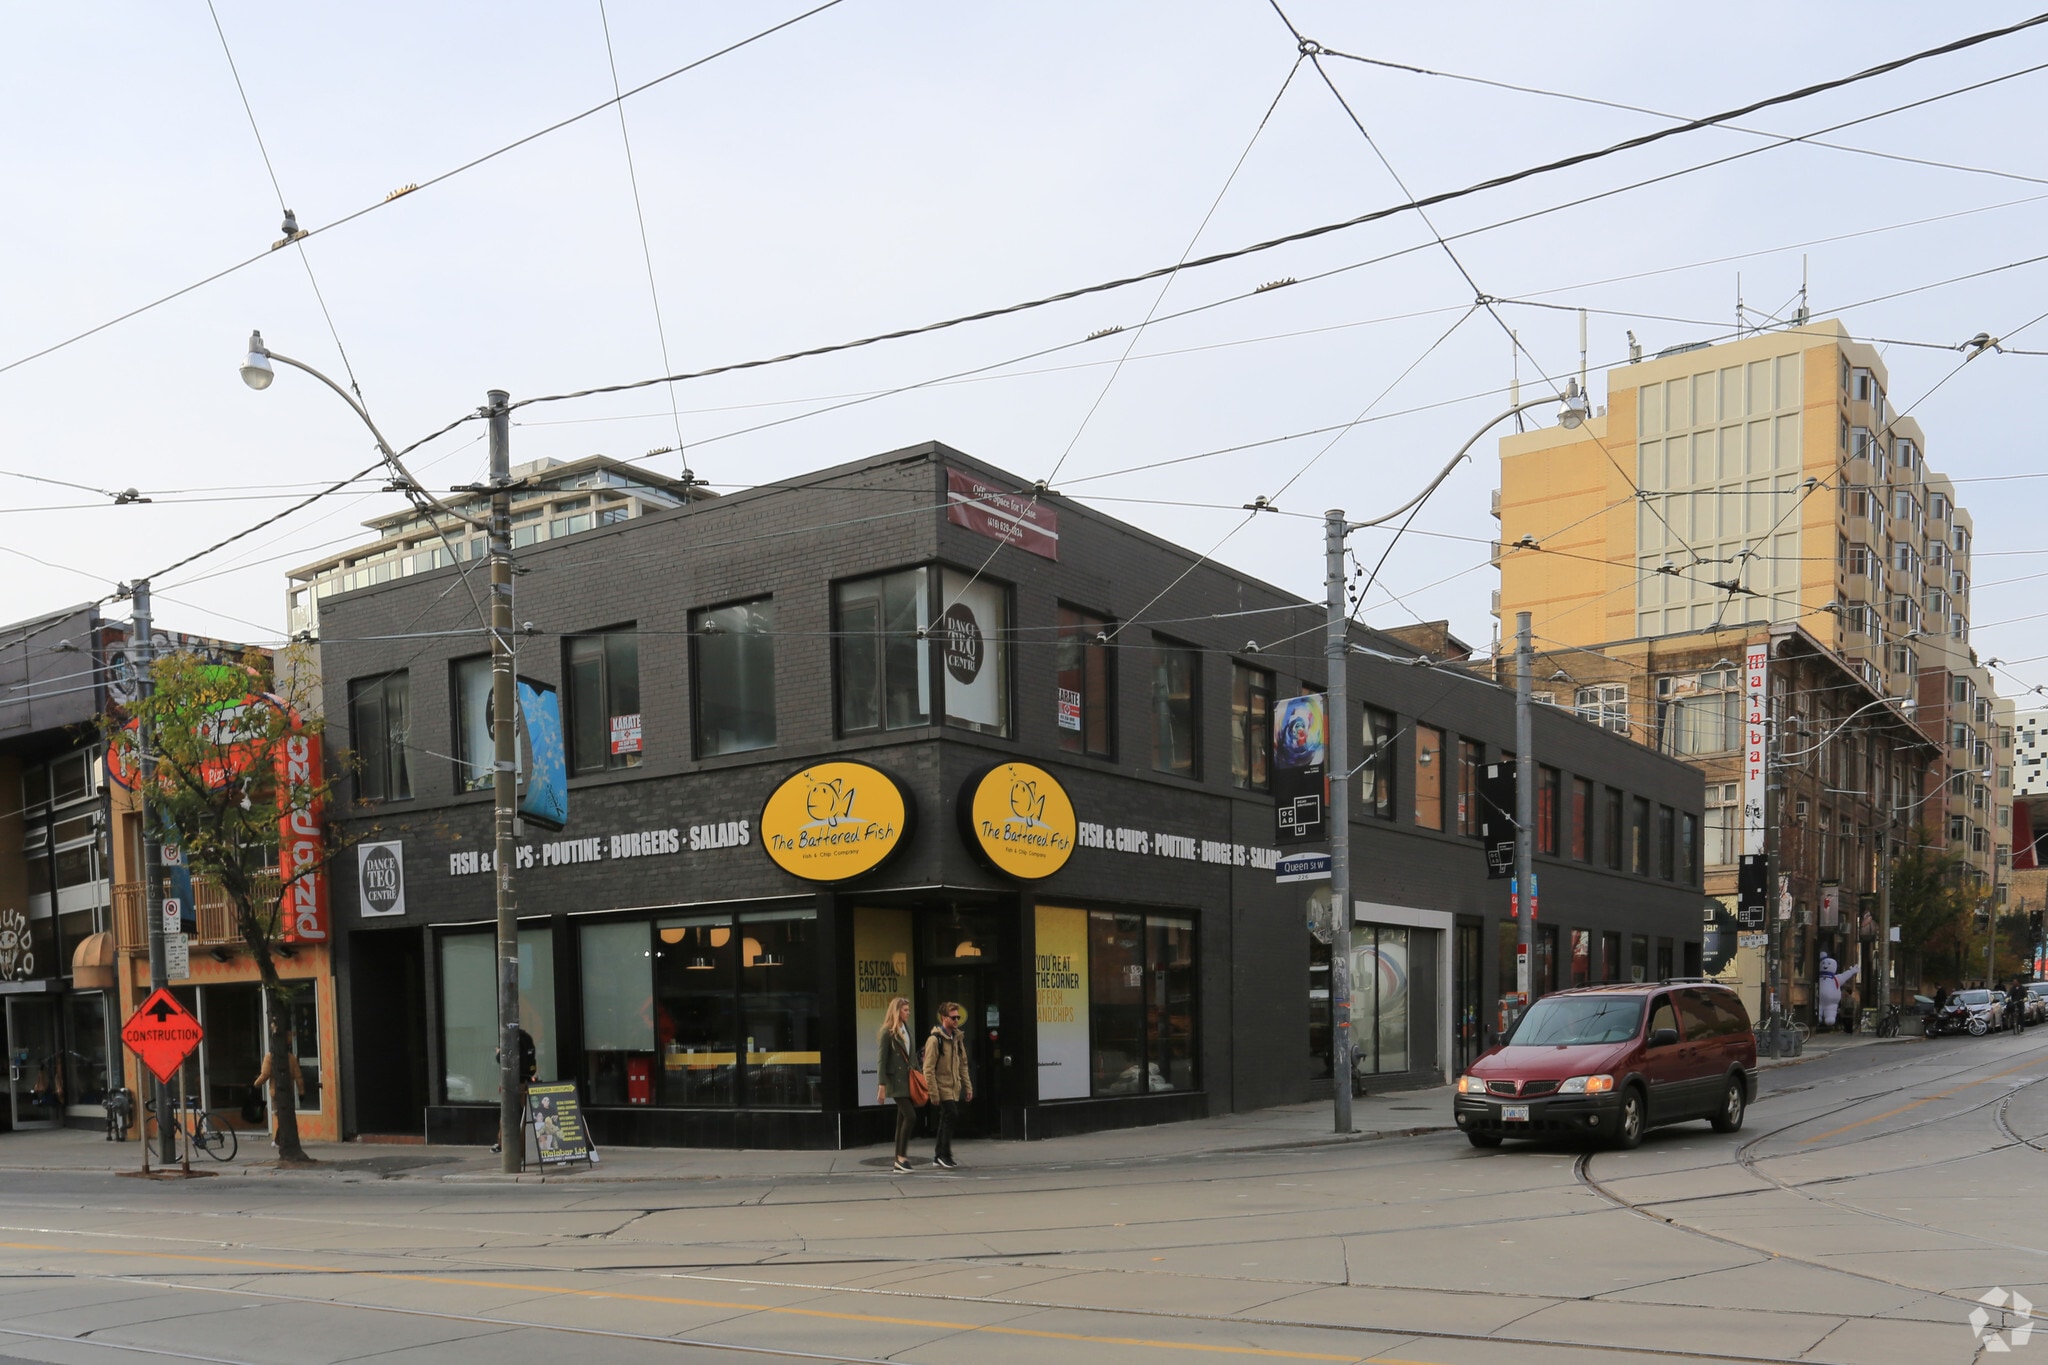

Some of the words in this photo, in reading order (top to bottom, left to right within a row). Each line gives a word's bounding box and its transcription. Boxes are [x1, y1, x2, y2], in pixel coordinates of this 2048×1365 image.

[972, 484, 993, 501] Office
[993, 494, 1011, 508] Space
[1010, 499, 1019, 512] for
[948, 630, 976, 660] TEQ
[613, 714, 641, 730] KARATE
[1747, 653, 1766, 781] Malabar
[287, 735, 321, 835] piza
[772, 834, 794, 851] The
[798, 827, 860, 849] Battered
[864, 822, 895, 840] Fish
[982, 821, 1001, 839] The
[1003, 823, 1048, 847] Battered
[1050, 832, 1071, 850] Fish
[1078, 821, 1104, 848] FISH
[1105, 829, 1115, 849] &
[1116, 827, 1149, 854] CHIPS
[1154, 833, 1196, 860] POUTINE
[449, 851, 479, 876] FISH
[480, 852, 491, 873] &
[493, 845, 534, 871] CPS
[543, 837, 601, 866] POUTINE
[611, 828, 679, 859] BURGERS
[690, 820, 750, 851] SALADS
[833, 849, 859, 857] Company
[367, 858, 395, 871] DANCE
[1284, 861, 1309, 873] Queen
[1310, 861, 1317, 870] St
[1317, 860, 1324, 869] W
[367, 869, 396, 890] TEQ
[368, 890, 397, 901] CENTRE
[859, 960, 879, 976] EAST
[880, 960, 907, 977] COAST
[1036, 953, 1062, 972] YOU'RE
[1063, 956, 1071, 972] AT
[859, 977, 887, 992] COMES
[888, 977, 898, 992] TO
[1036, 972, 1052, 988] THE
[1051, 972, 1079, 989] CORNER
[860, 993, 885, 1009] QUEEN
[1037, 990, 1047, 1005] OF
[1047, 990, 1063, 1005] FISH
[1037, 1006, 1053, 1022] AND
[1052, 1007, 1074, 1022] CHIPS
[126, 1028, 199, 1043] CONSTRUCTION
[540, 1148, 573, 1159] Malabar
[575, 1146, 587, 1156] Ltd
